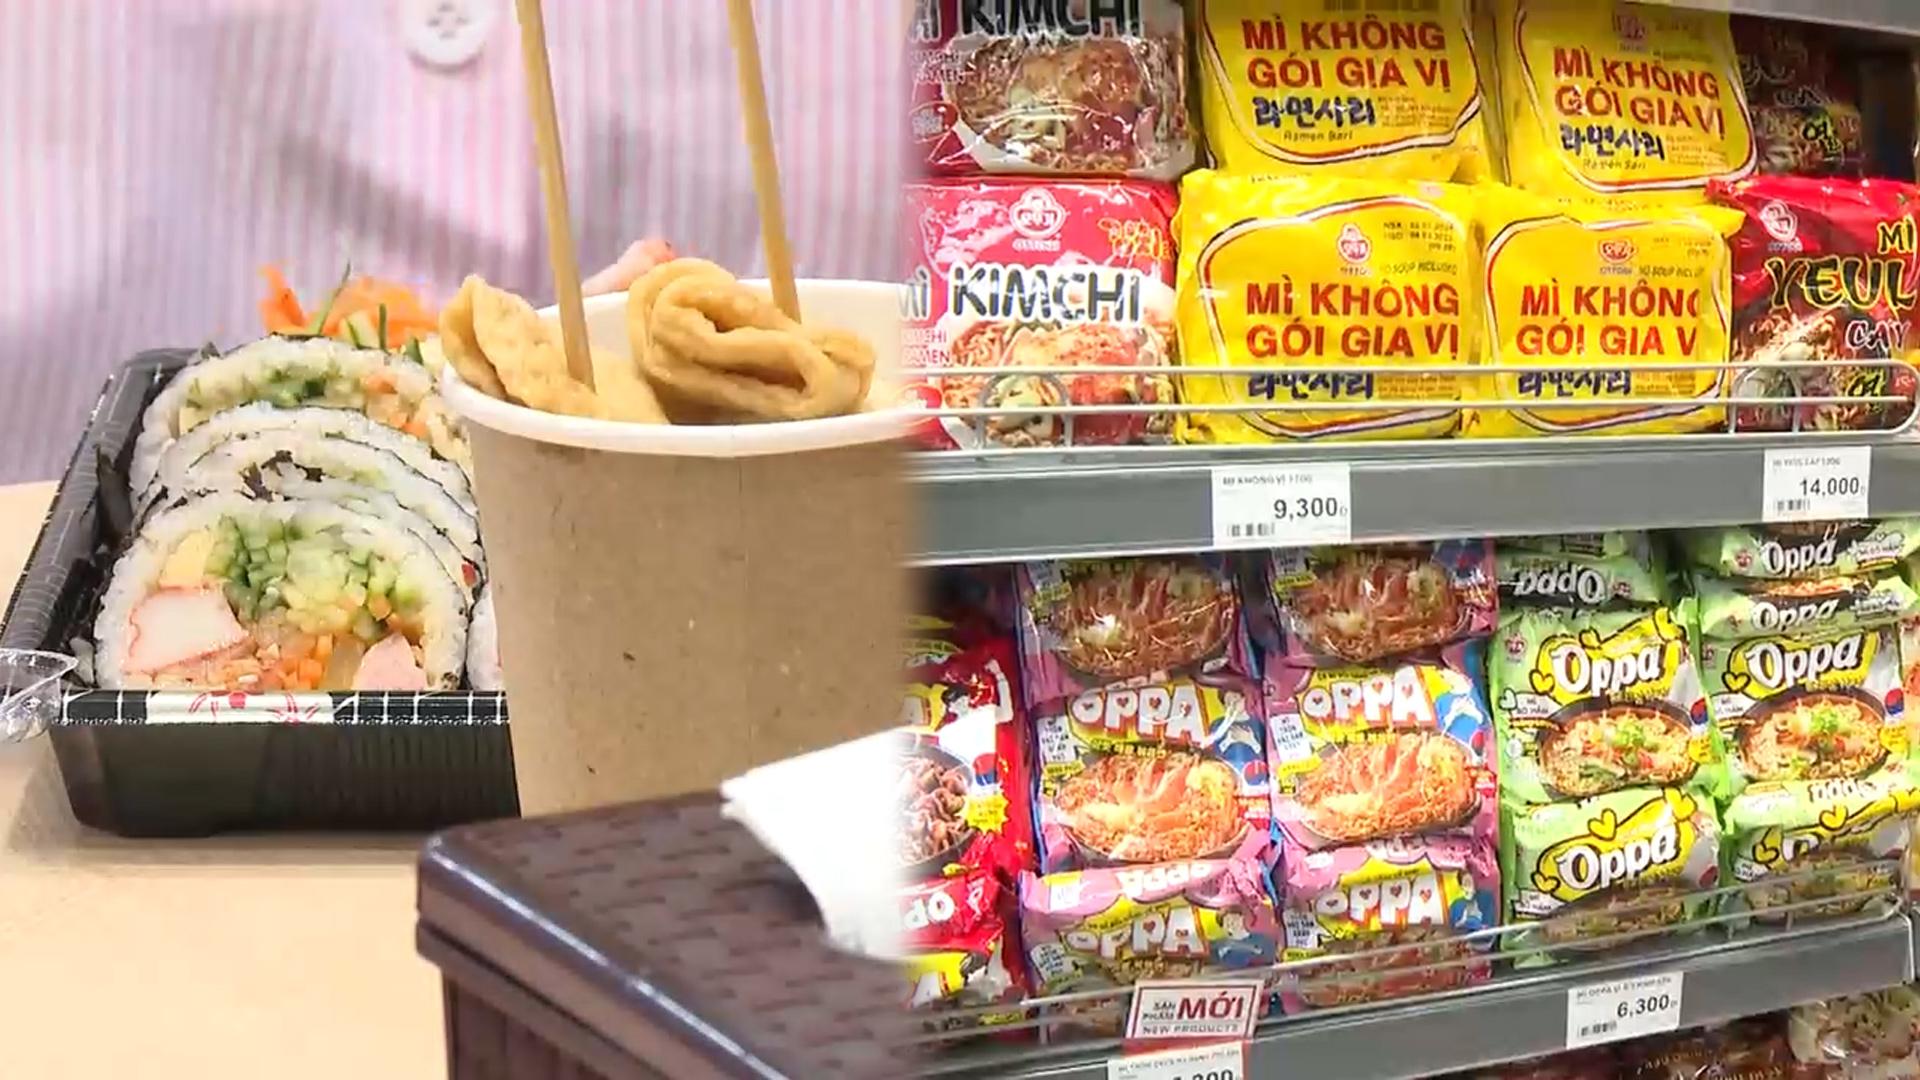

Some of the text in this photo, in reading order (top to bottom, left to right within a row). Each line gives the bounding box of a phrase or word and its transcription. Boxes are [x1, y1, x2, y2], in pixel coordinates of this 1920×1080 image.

[1241, 14, 1446, 51] MÌ KHÔNG
[1247, 52, 1323, 89] GÓI
[1414, 58, 1452, 93] VỊ
[1553, 44, 1594, 80] MÌ
[1602, 58, 1720, 100] KHÔNG
[1252, 95, 1377, 128] 라면사리
[1555, 81, 1727, 141] GÓI GIA VỊ
[1559, 122, 1666, 161] 라면사리
[951, 265, 1143, 325] KIMCHI
[1246, 275, 1459, 318] MÌ KHÔNG
[1520, 278, 1560, 317] MÌ
[1765, 255, 1918, 312] YEUL
[1246, 317, 1459, 361] GÓI GIA VỊ
[1516, 319, 1584, 356] GÓI
[1599, 325, 1665, 356] GIA
[1846, 320, 1909, 350] CAY
[1761, 536, 1838, 578] Oppa
[1751, 597, 1841, 634] Oppa
[1549, 643, 1666, 698] Oppa
[1745, 631, 1865, 691] Oppa
[1070, 682, 1211, 748] OPPA
[1301, 664, 1435, 725] OPPA
[1555, 821, 1678, 890] Oppa
[1314, 871, 1445, 926] OPPA
[1065, 906, 1209, 960] OPPA
[1177, 990, 1244, 1021] MỚI
[1142, 1022, 1239, 1036] NEW PRODUCTS
